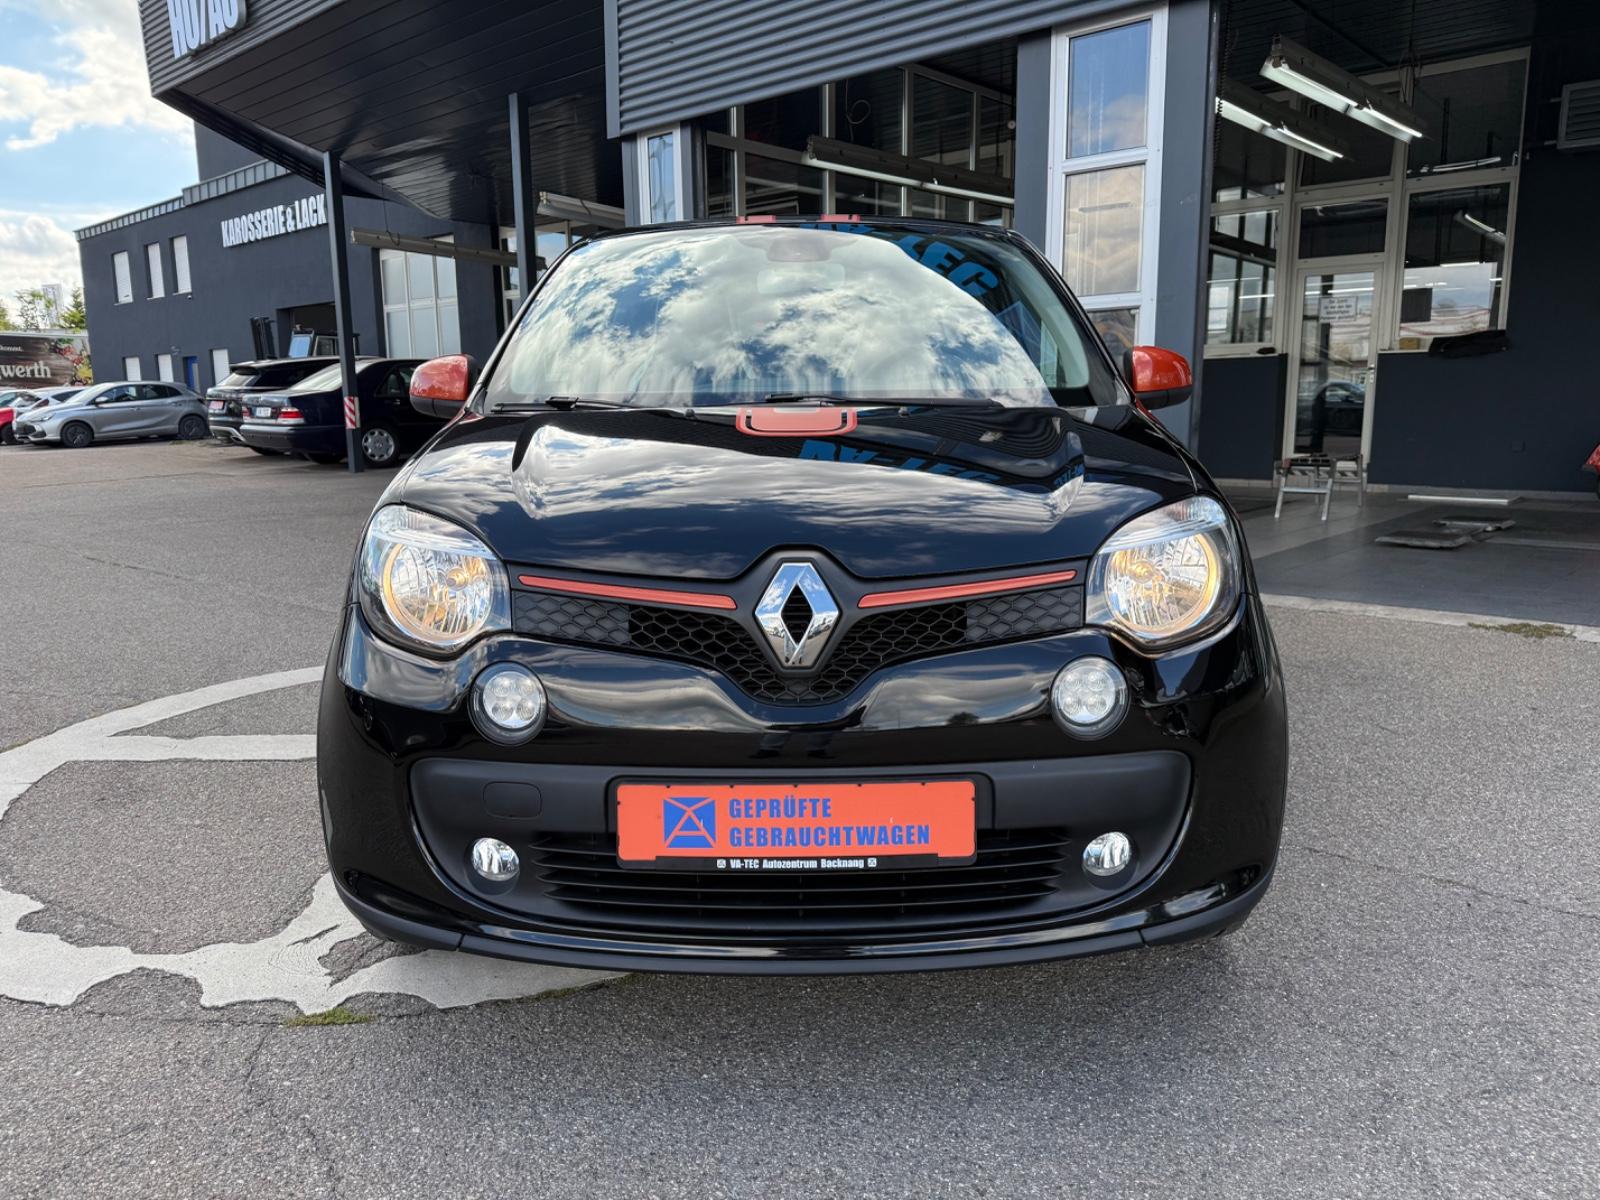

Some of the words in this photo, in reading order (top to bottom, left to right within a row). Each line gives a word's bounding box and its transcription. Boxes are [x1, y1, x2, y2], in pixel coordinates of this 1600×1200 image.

[294, 193, 327, 230] LACK
[0, 360, 52, 380] werth
[729, 795, 832, 819] GEPRÜFTE
[729, 824, 930, 847] GEBRAUCHTWAGEN
[730, 859, 760, 869] VA-TEC
[762, 859, 818, 869] Autozentrum
[820, 858, 865, 869] Backnang
